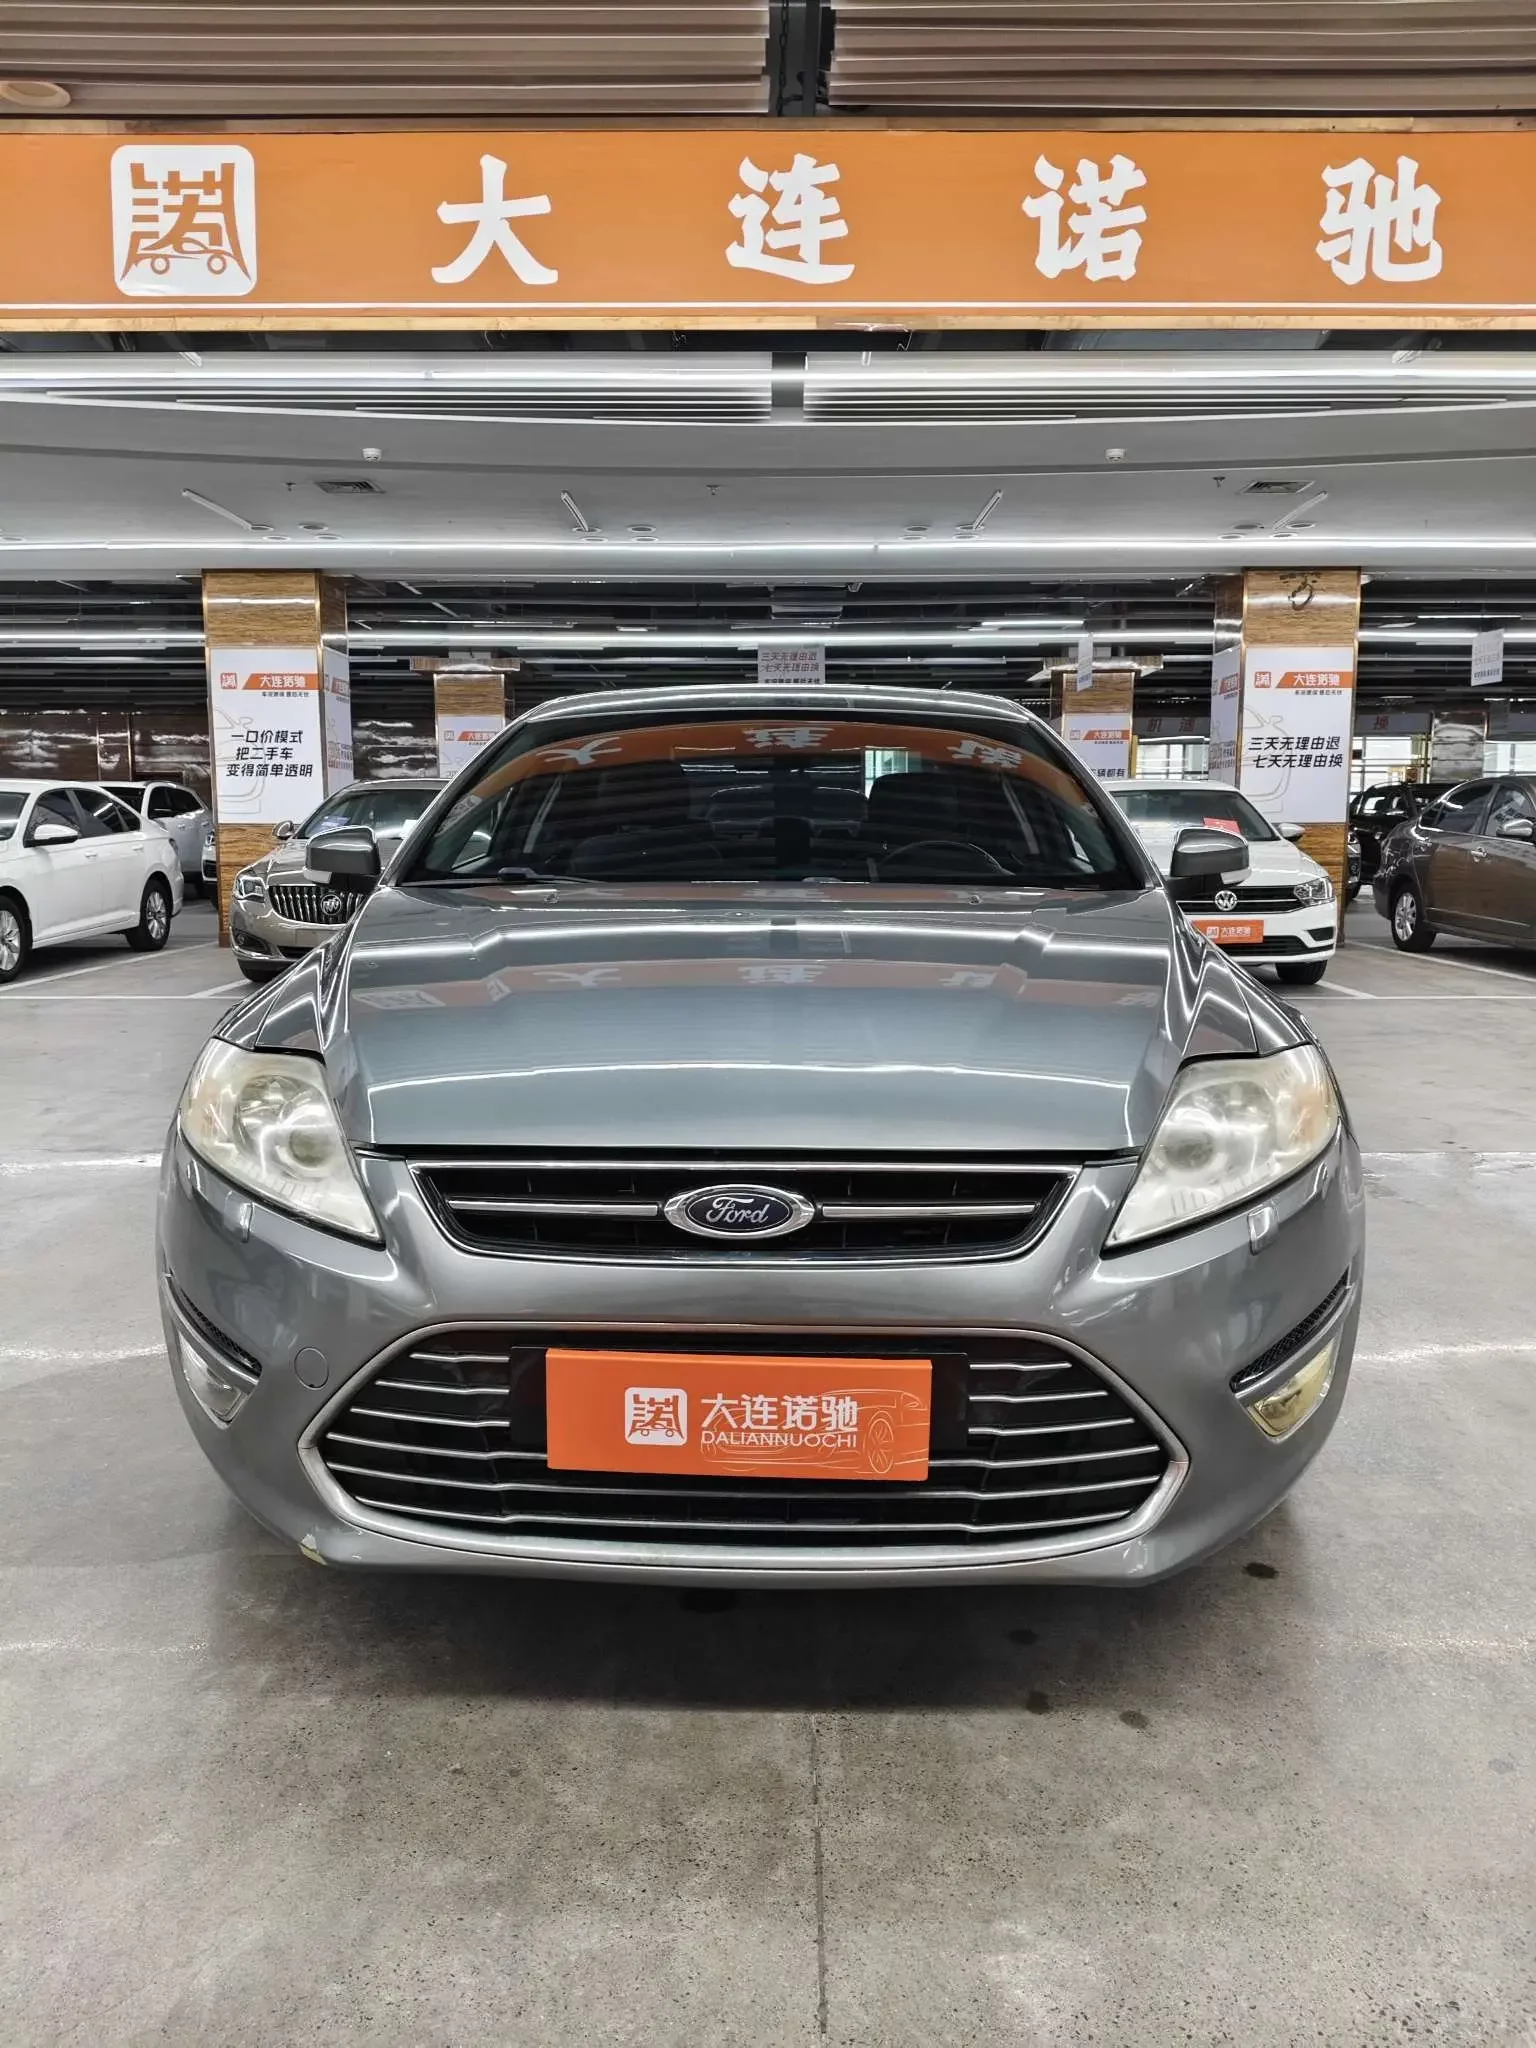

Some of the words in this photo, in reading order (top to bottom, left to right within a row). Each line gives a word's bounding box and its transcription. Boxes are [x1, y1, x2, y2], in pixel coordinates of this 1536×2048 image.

[431, 152, 1443, 286] 大连诺驰
[260, 675, 306, 688] 大连诺驰
[1293, 674, 1340, 686] 大连诺驰
[231, 730, 303, 744] 一口价模式
[1248, 736, 1341, 751] 三天无理由退
[235, 747, 294, 760] 把二手车
[1253, 753, 1343, 768] 七天无理由换
[226, 763, 313, 777] 变得简单透明
[706, 1197, 770, 1223] Ford
[701, 1393, 858, 1432] 大连诺驰
[702, 1430, 857, 1448] DALIANNUOCHI
